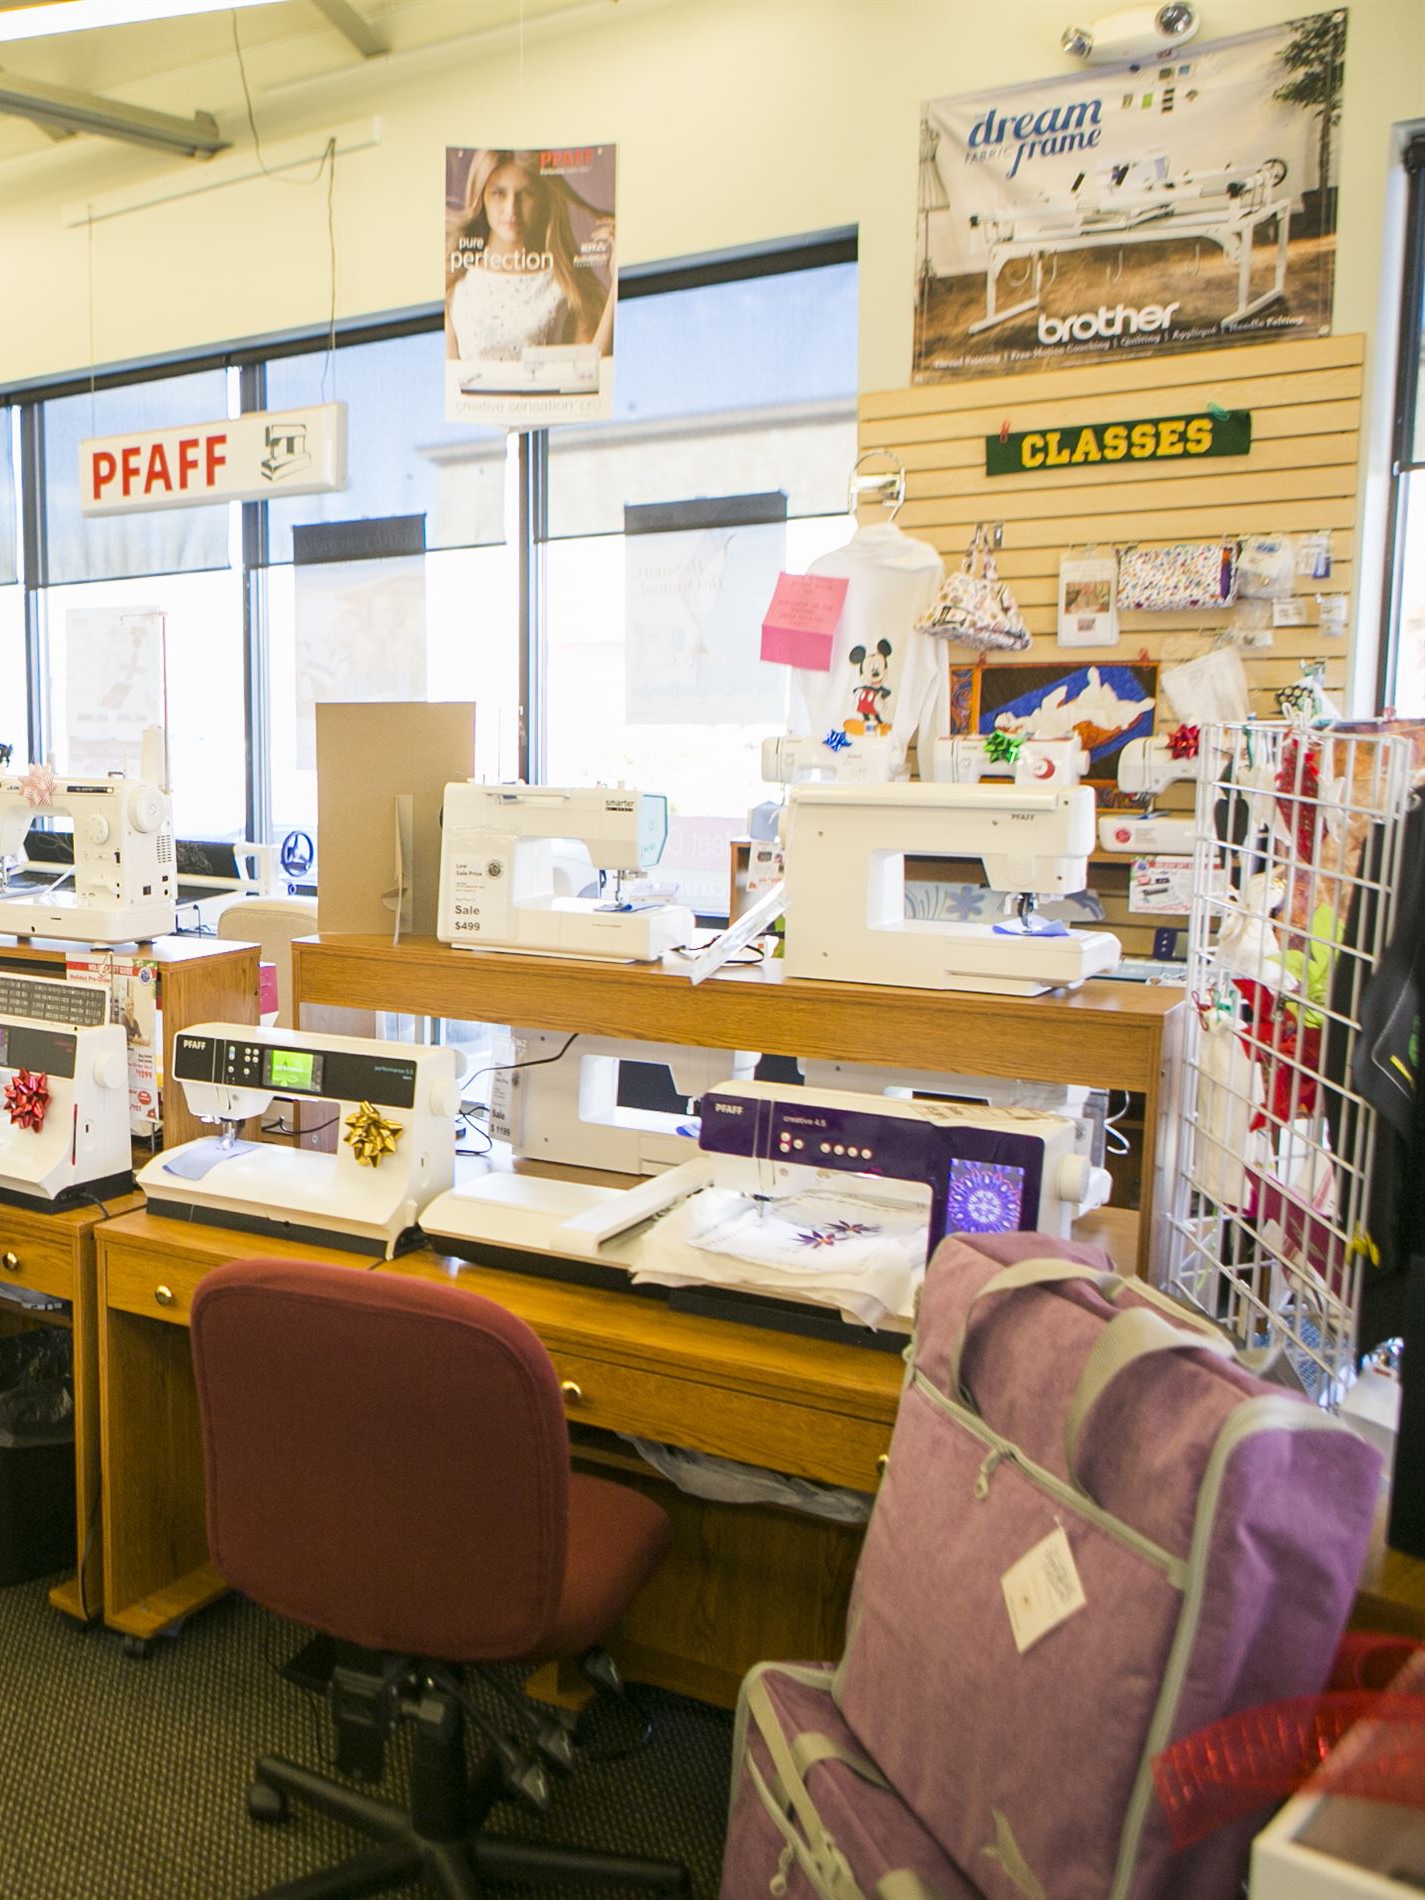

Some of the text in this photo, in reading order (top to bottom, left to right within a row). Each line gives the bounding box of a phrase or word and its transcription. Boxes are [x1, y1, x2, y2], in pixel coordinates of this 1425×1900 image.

[968, 98, 1102, 148] dream
[539, 148, 594, 167] PFAFF
[965, 128, 1101, 179] FABRIC frame
[459, 236, 484, 250] pure
[451, 248, 554, 273] perfection
[1038, 301, 1181, 344] brother
[1021, 418, 1213, 468] CLASSES
[92, 434, 227, 500] PFAFF
[605, 799, 635, 808] smarter
[1011, 813, 1035, 821] PFAFF
[455, 904, 480, 915] Sale
[455, 921, 481, 931] $499
[183, 1039, 206, 1050] PFAFF
[715, 1103, 744, 1115] PFAFF
[782, 1115, 813, 1125] creative
